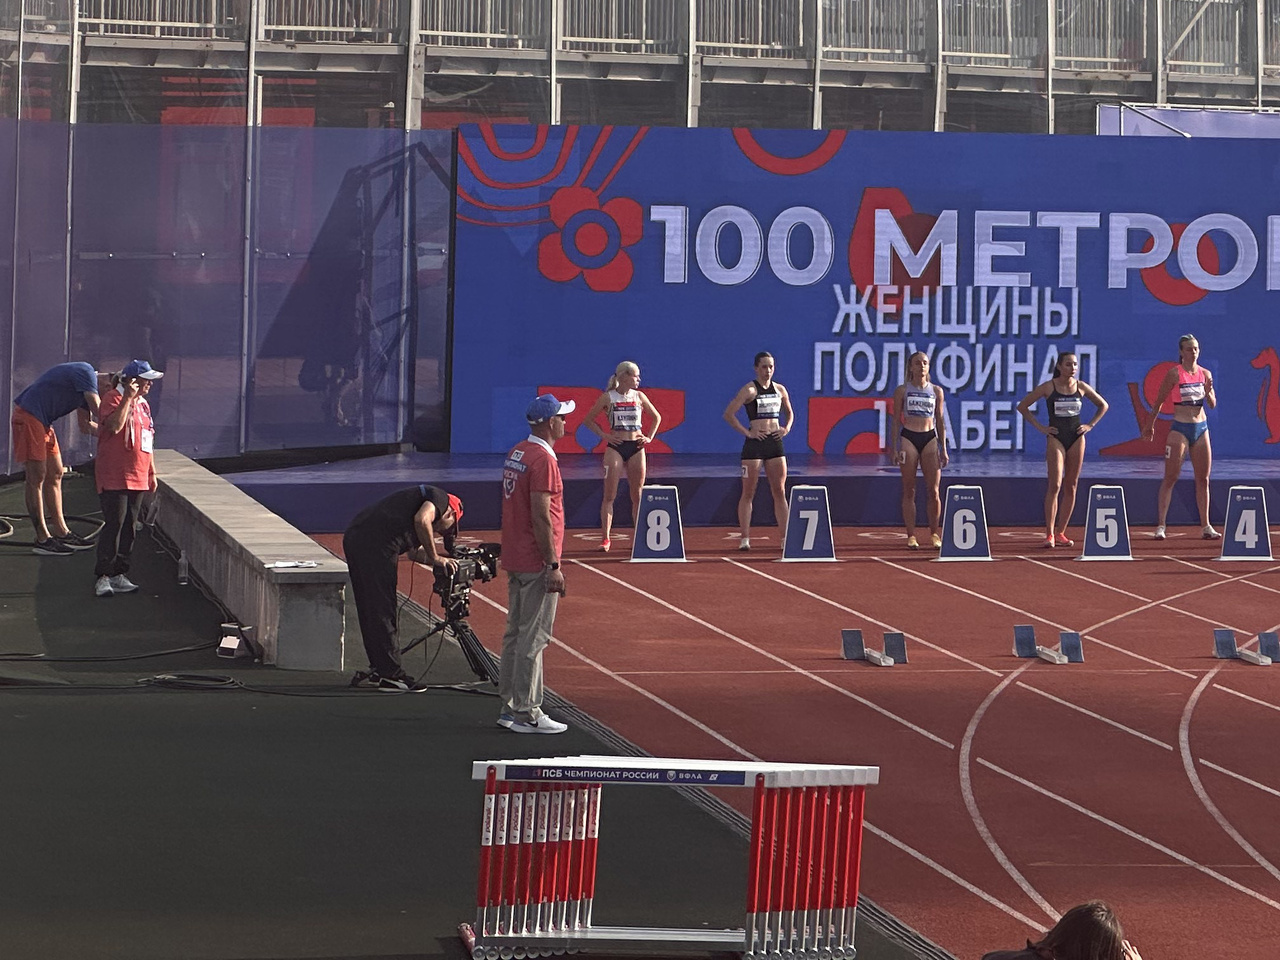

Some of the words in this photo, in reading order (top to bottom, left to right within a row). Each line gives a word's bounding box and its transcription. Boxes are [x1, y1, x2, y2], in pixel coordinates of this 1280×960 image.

[650, 205, 834, 286] 100
[832, 284, 1079, 344] ЖЕНЩИНЫ
[940, 400, 1037, 449] БЕГ
[645, 509, 671, 551] 8
[799, 510, 820, 551] 7
[952, 508, 977, 550] 6
[1095, 508, 1119, 549] 5
[1234, 510, 1259, 549] 4
[542, 769, 563, 778] ПСБ
[564, 770, 621, 779] ЧЕМПИОНАТ
[622, 771, 659, 779] РОССИИ
[485, 806, 493, 833] polanik
[499, 805, 507, 832] polanik
[526, 804, 534, 830] polanik
